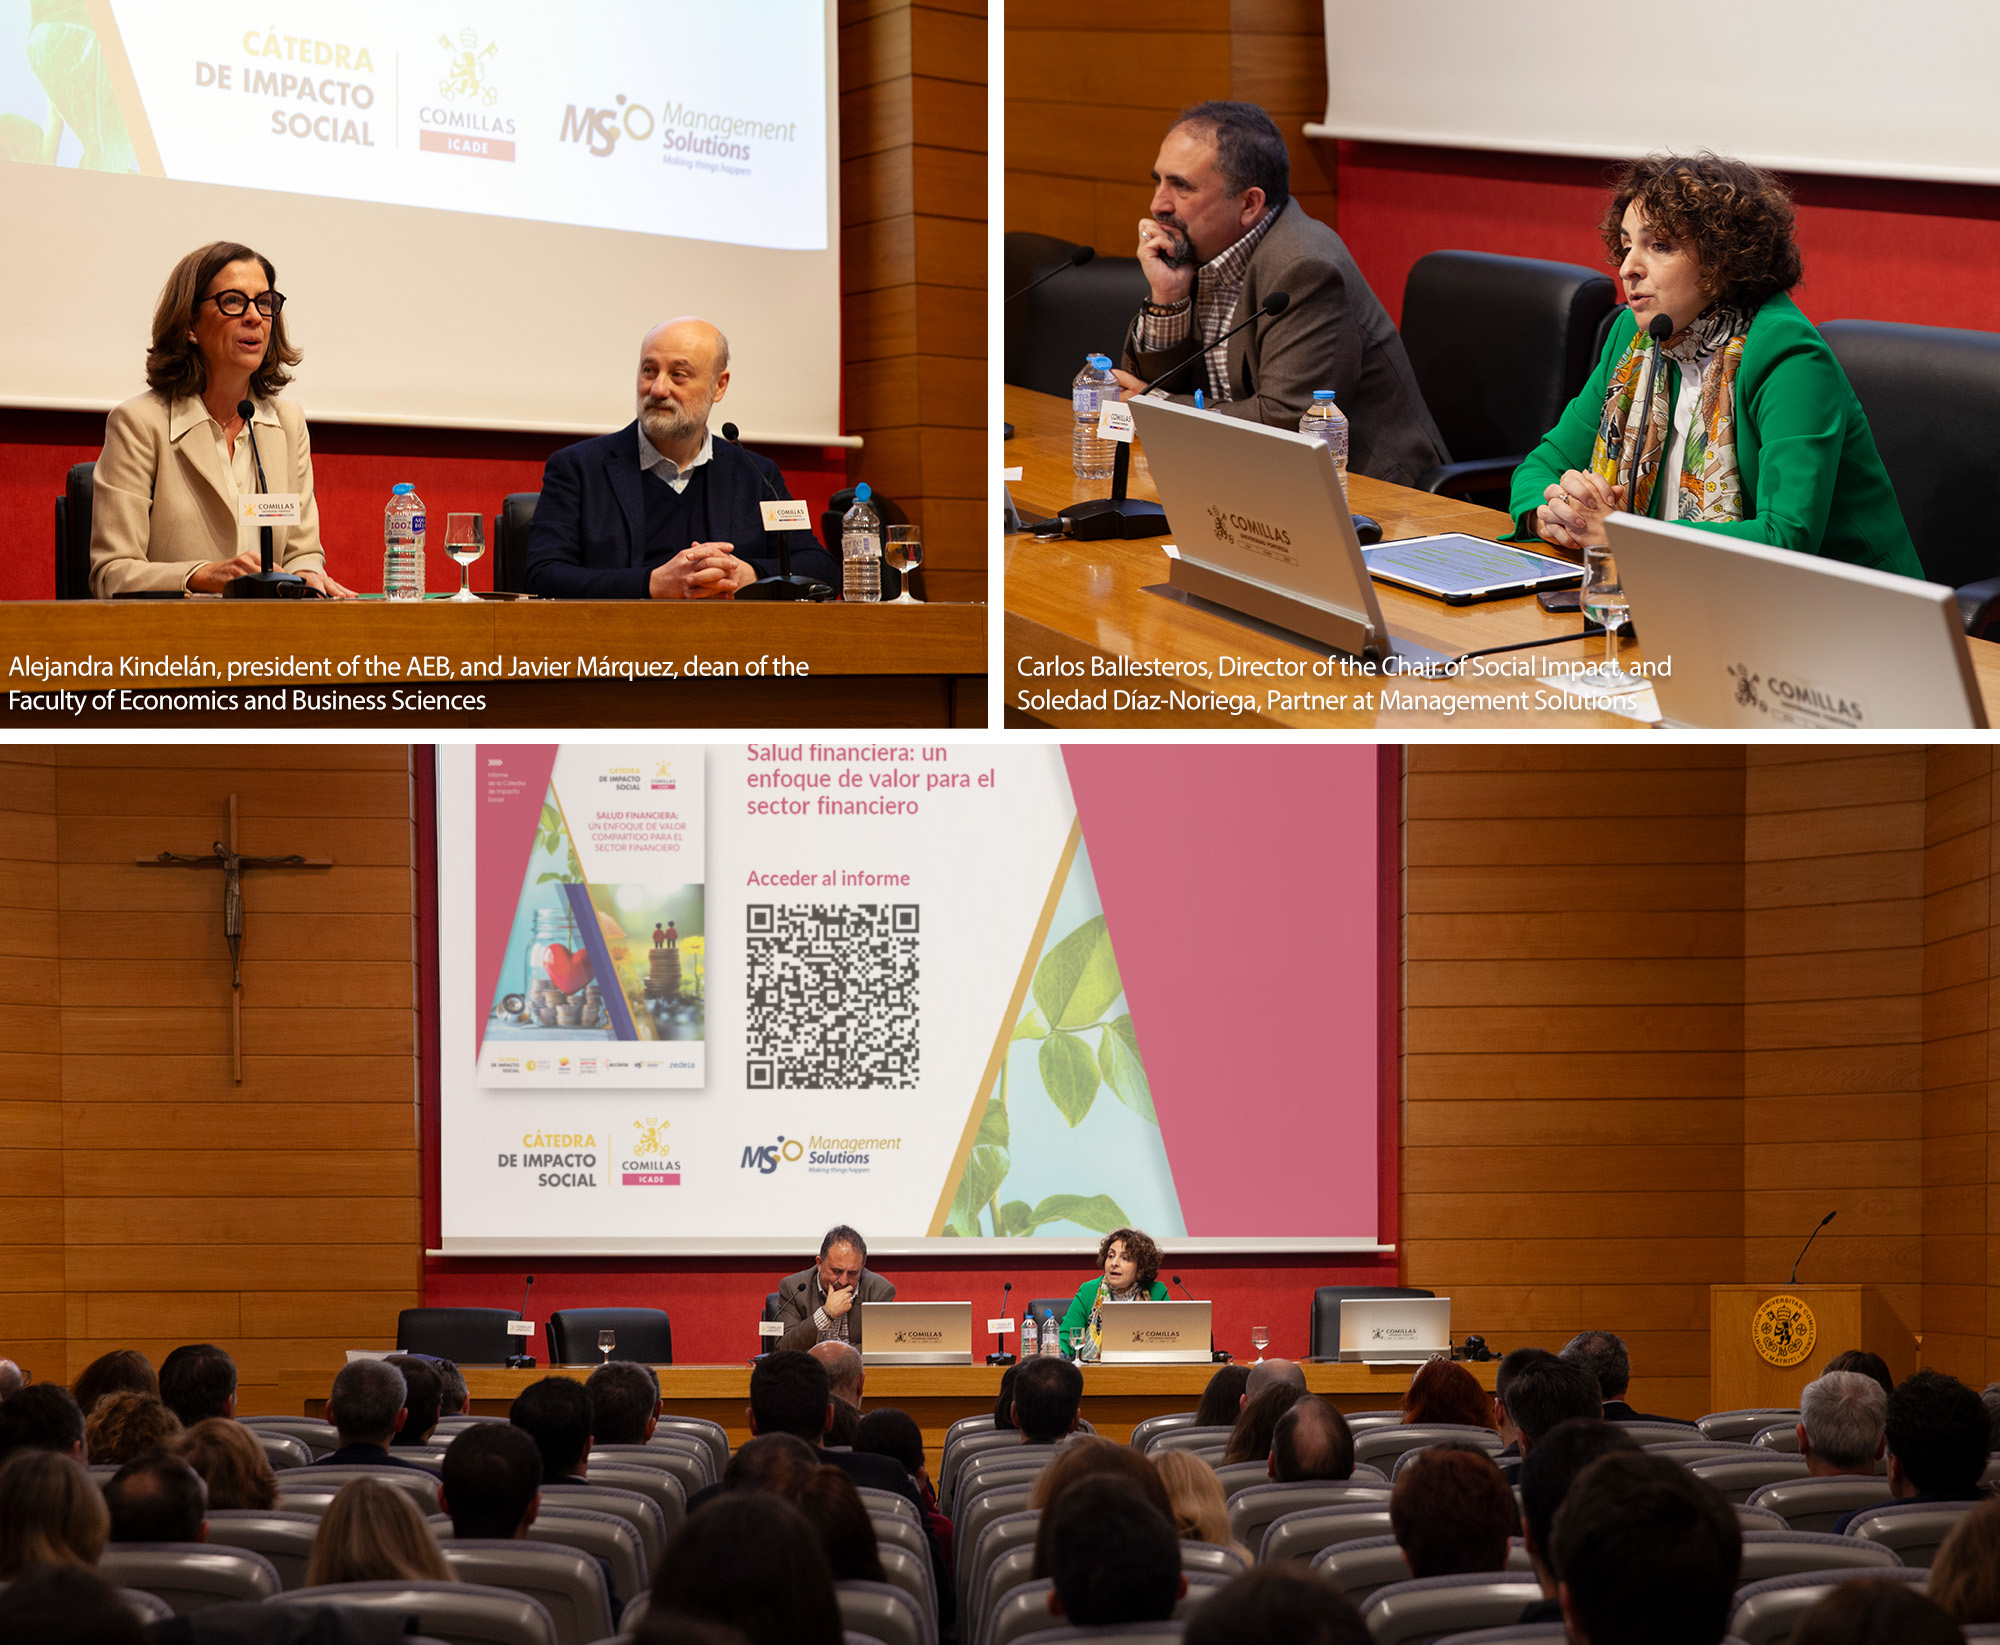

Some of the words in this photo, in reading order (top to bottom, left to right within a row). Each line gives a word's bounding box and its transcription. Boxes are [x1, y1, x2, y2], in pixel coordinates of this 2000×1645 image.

[243, 25, 374, 73] CÁTEDRA
[195, 61, 232, 90] DE
[244, 67, 375, 110] IMPACTO
[271, 110, 375, 147] SOCIAL
[420, 107, 516, 134] COMILLAS
[662, 101, 797, 143] Management
[447, 137, 489, 155] ICADE
[663, 128, 751, 161] Solutions
[662, 154, 694, 171] Making
[695, 158, 720, 175] things
[721, 161, 751, 177] happen
[1230, 514, 1291, 545] COMILLAS
[1768, 677, 1863, 720] COMILLAS
[747, 744, 802, 761] Salud
[809, 744, 914, 761] financiera:
[922, 747, 947, 761] un
[747, 768, 831, 792] enfoque
[838, 768, 863, 788] de
[869, 768, 920, 788] valor
[927, 773, 970, 792] para
[978, 768, 995, 788] el
[747, 797, 810, 815] sector
[817, 796, 919, 815] financiero
[596, 812, 624, 820] SALUD
[626, 812, 679, 820] FINANCIERA:
[588, 822, 601, 830] UN
[603, 822, 644, 831] ENFOQUE
[646, 822, 658, 830] DE
[659, 822, 687, 830] VALOR
[592, 833, 648, 841] COMPARTIDO
[650, 833, 672, 841] PARA
[674, 833, 683, 841] EL
[595, 844, 627, 852] SECTOR
[629, 844, 680, 852] FINANCIERO
[747, 869, 818, 886] Acceder
[822, 869, 836, 886] al
[842, 869, 910, 886] informe
[669, 1061, 695, 1069] redeia
[523, 1130, 596, 1148] CÁTEDRA
[809, 1135, 901, 1153] Management
[498, 1154, 517, 1168] DE
[523, 1153, 597, 1168] IMPACTO
[622, 1161, 681, 1171] COMILLAS
[809, 1151, 869, 1165] Solutions
[639, 1176, 664, 1184] ICADE
[809, 1167, 829, 1175] Making
[831, 1167, 847, 1175] things
[538, 1173, 596, 1188] SOCIAL
[1754, 1313, 1766, 1354] PONTIFICIA
[1761, 1298, 1803, 1312] UNIVERSITAS
[1800, 1309, 1814, 1356] COMILLENSIS
[1769, 1355, 1797, 1364] MATRITI
